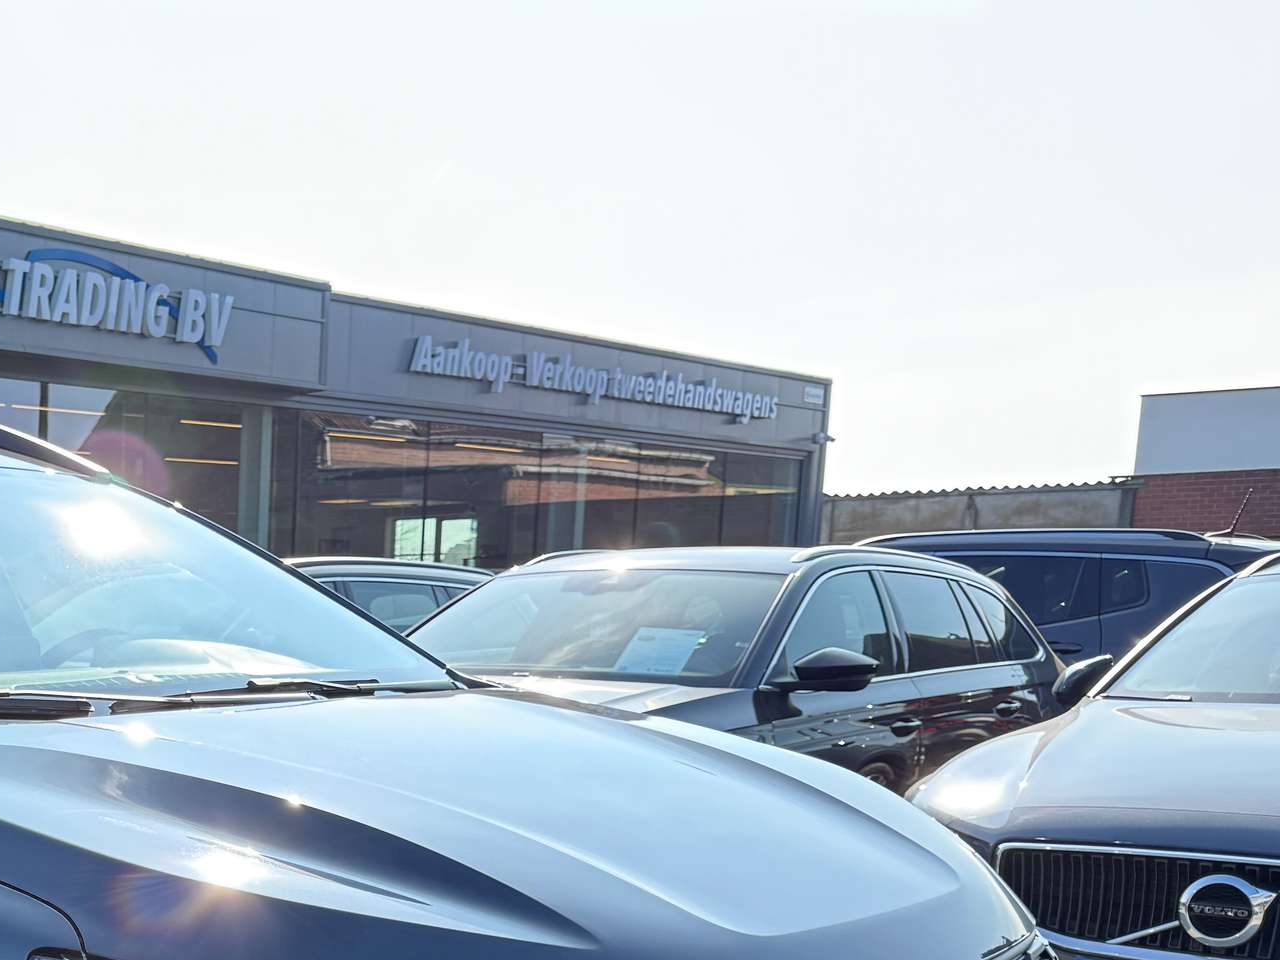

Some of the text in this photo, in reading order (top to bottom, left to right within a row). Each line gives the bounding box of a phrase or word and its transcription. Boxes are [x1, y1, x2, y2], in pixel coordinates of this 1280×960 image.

[1, 257, 170, 338] TRADING
[175, 288, 234, 347] BV
[610, 367, 778, 425] tweedehandswagens
[1191, 904, 1249, 918] VOLVO
